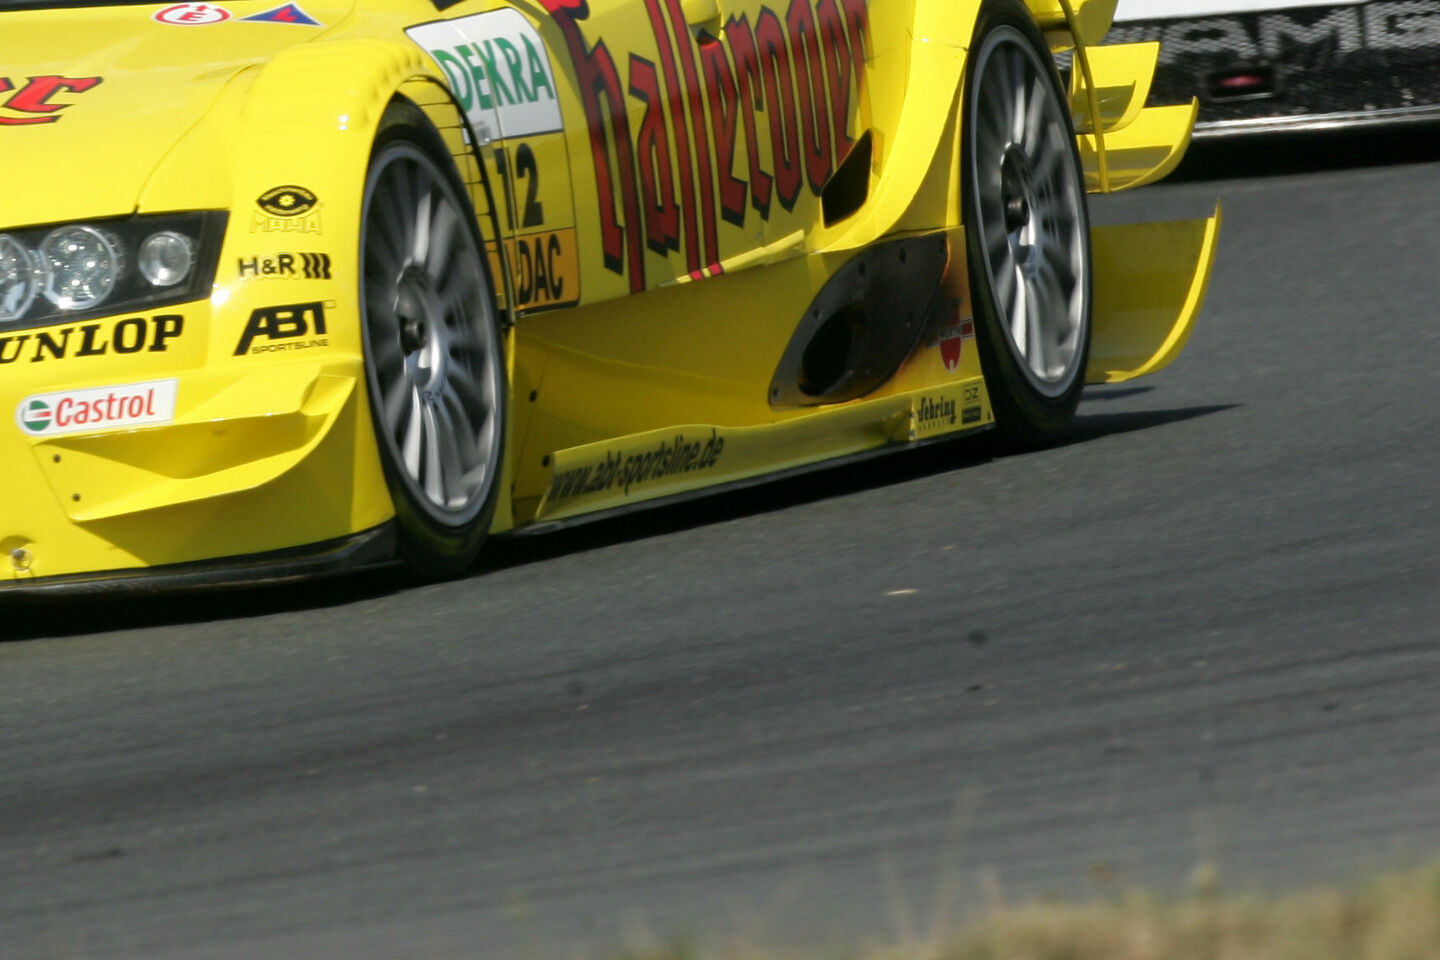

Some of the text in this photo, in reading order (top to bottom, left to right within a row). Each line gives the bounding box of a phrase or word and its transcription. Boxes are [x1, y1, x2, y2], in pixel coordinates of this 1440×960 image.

[432, 32, 555, 113] DEKRA
[494, 143, 544, 230] 12
[238, 253, 296, 278] H&R
[232, 301, 328, 357] ABT
[252, 339, 329, 355] SPORTSLINE
[56, 389, 156, 428] Castrol
